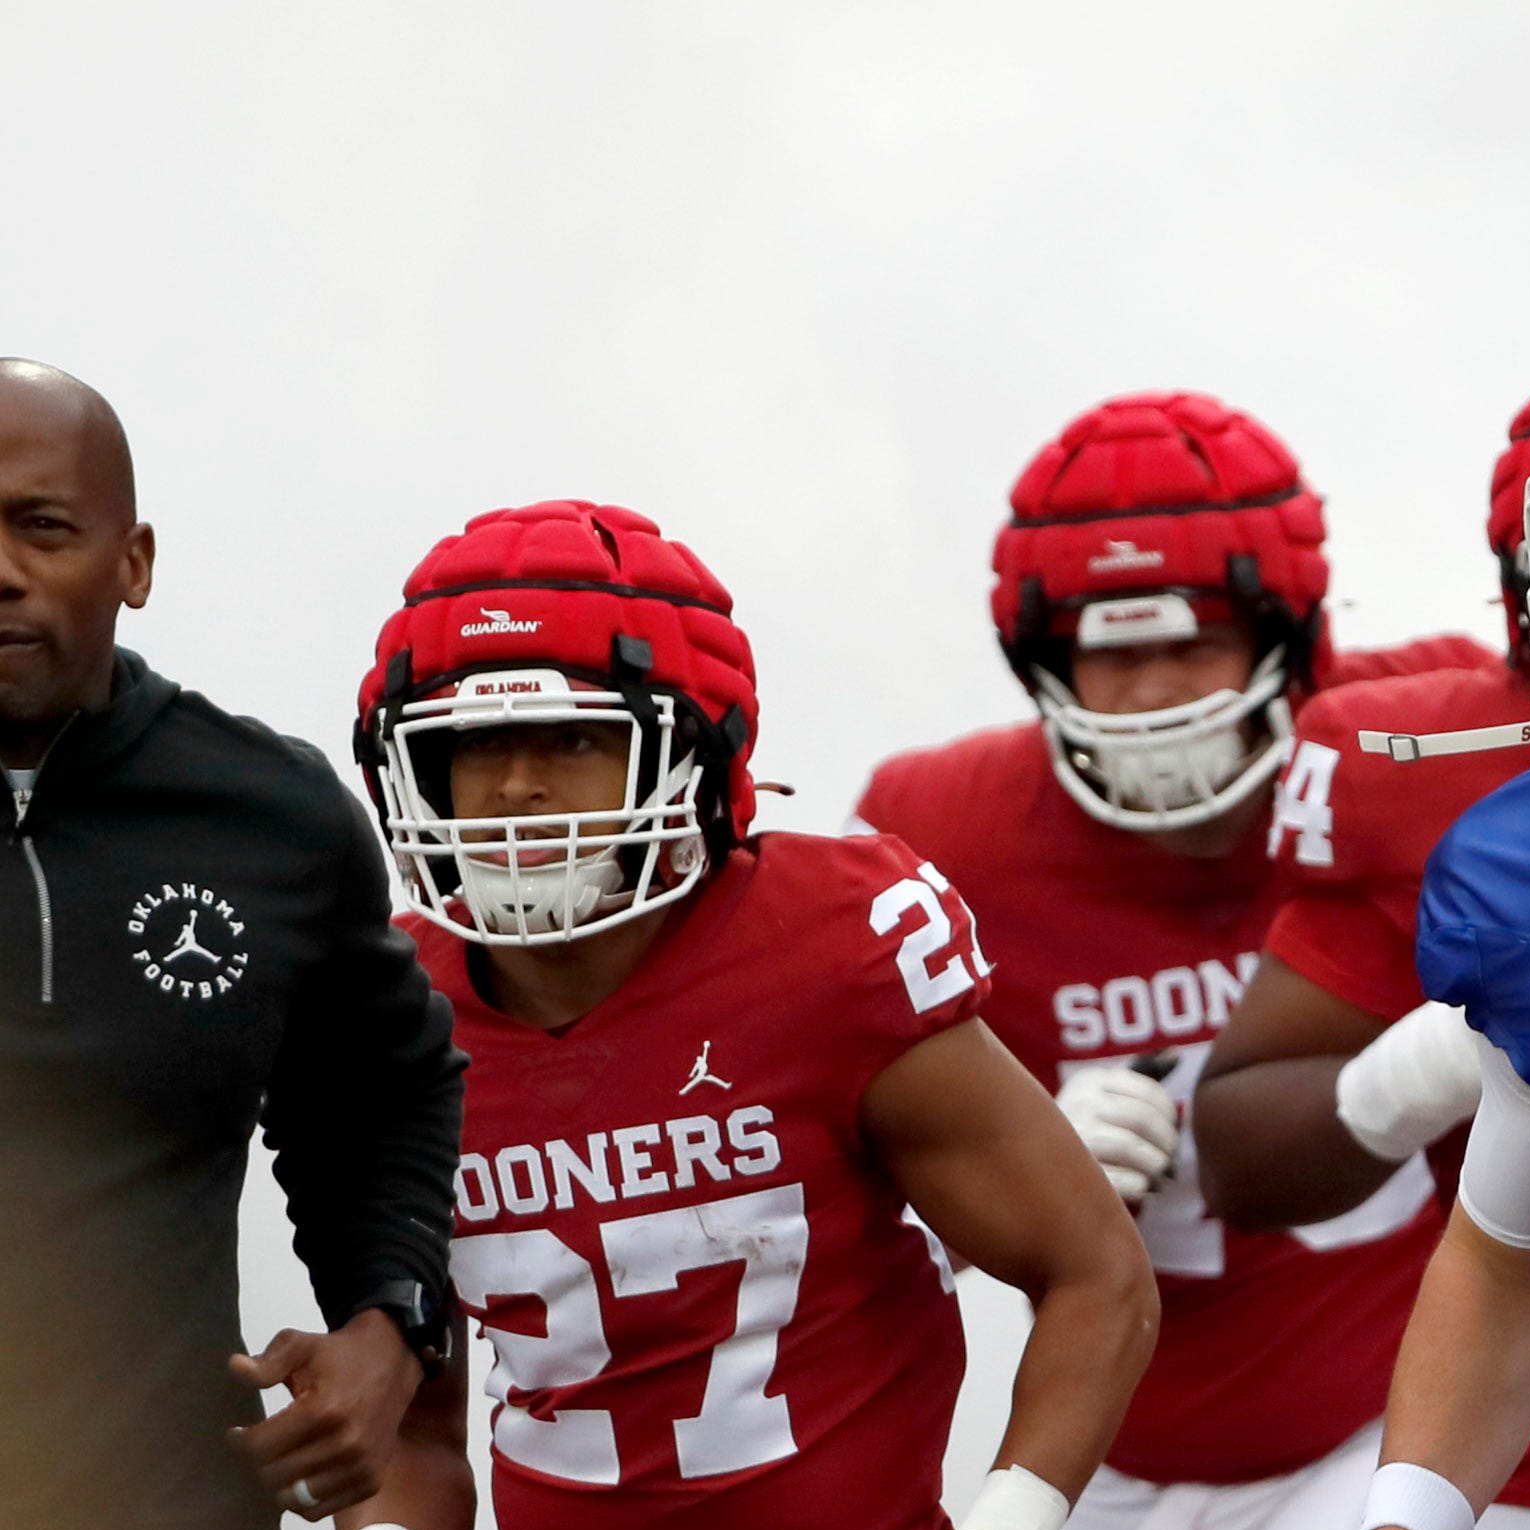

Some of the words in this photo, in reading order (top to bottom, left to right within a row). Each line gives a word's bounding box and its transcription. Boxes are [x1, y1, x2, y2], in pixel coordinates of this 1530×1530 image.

[460, 620, 538, 637] GUARDIAN
[128, 882, 246, 937] OKLAHOMA
[132, 949, 249, 999] FOOTBALL
[1053, 951, 1261, 1051] SOON
[452, 1104, 782, 1223] OONERS
[448, 1181, 810, 1486] 27
